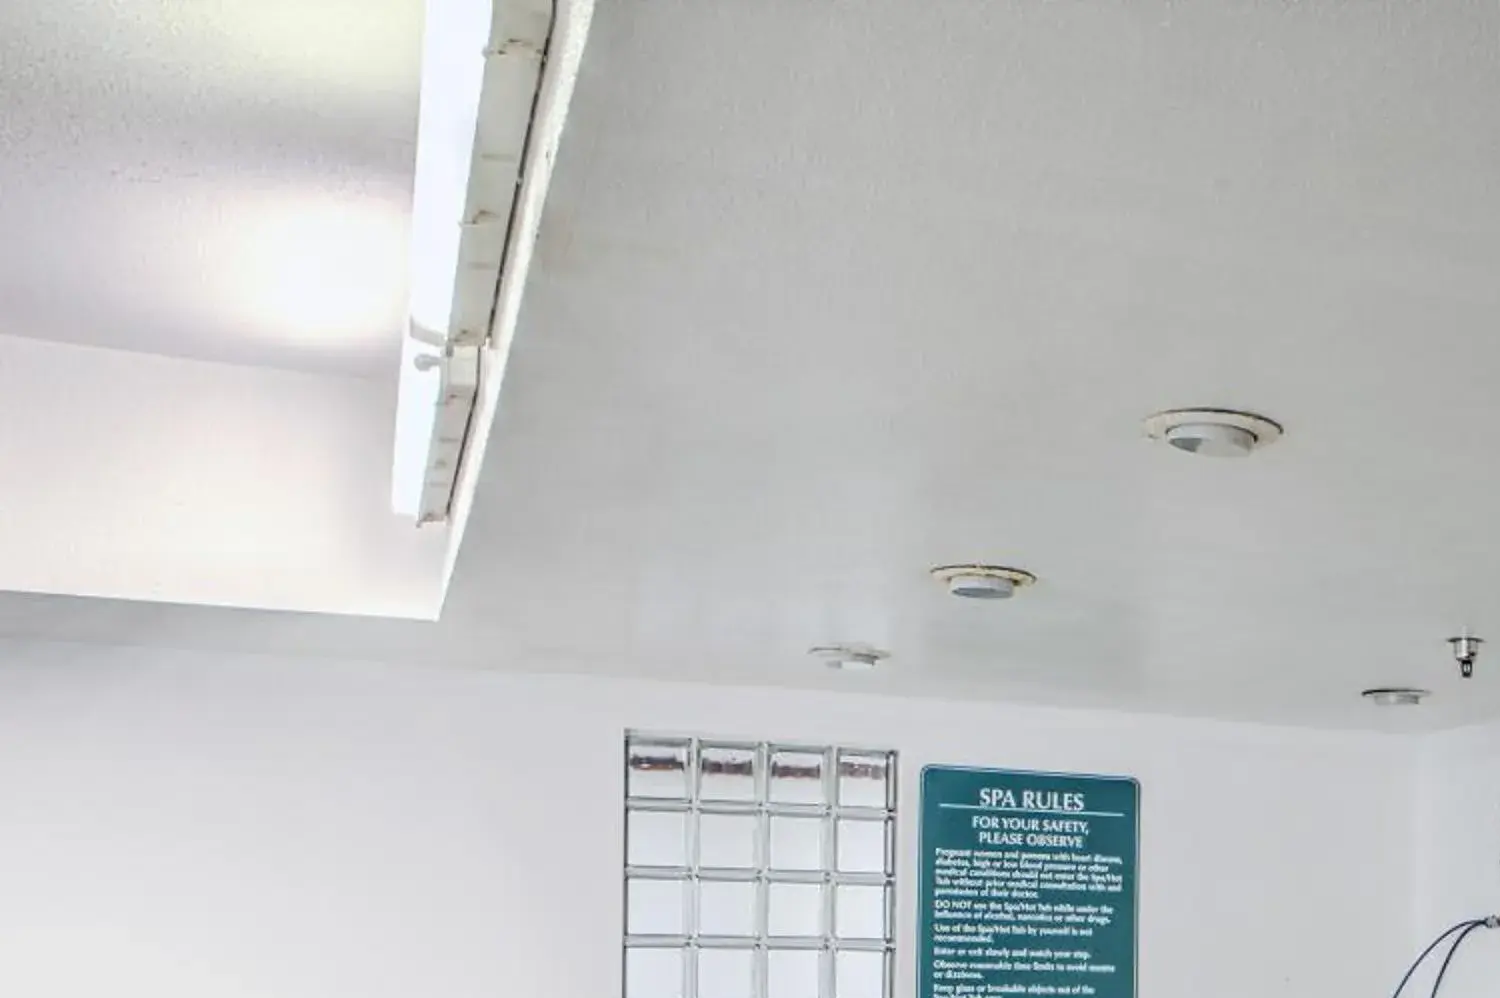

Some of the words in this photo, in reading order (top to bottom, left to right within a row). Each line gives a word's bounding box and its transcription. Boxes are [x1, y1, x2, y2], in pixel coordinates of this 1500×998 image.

[979, 788, 1015, 807] SPA
[1023, 792, 1085, 811] RULES
[972, 816, 999, 829] FOR
[1002, 817, 1042, 831] YOUR
[1043, 820, 1090, 835] SAFETY,
[979, 832, 1024, 846] PLEASE
[1026, 834, 1083, 849] OBSERVE
[935, 900, 950, 909] DO
[952, 900, 972, 909] NOT
